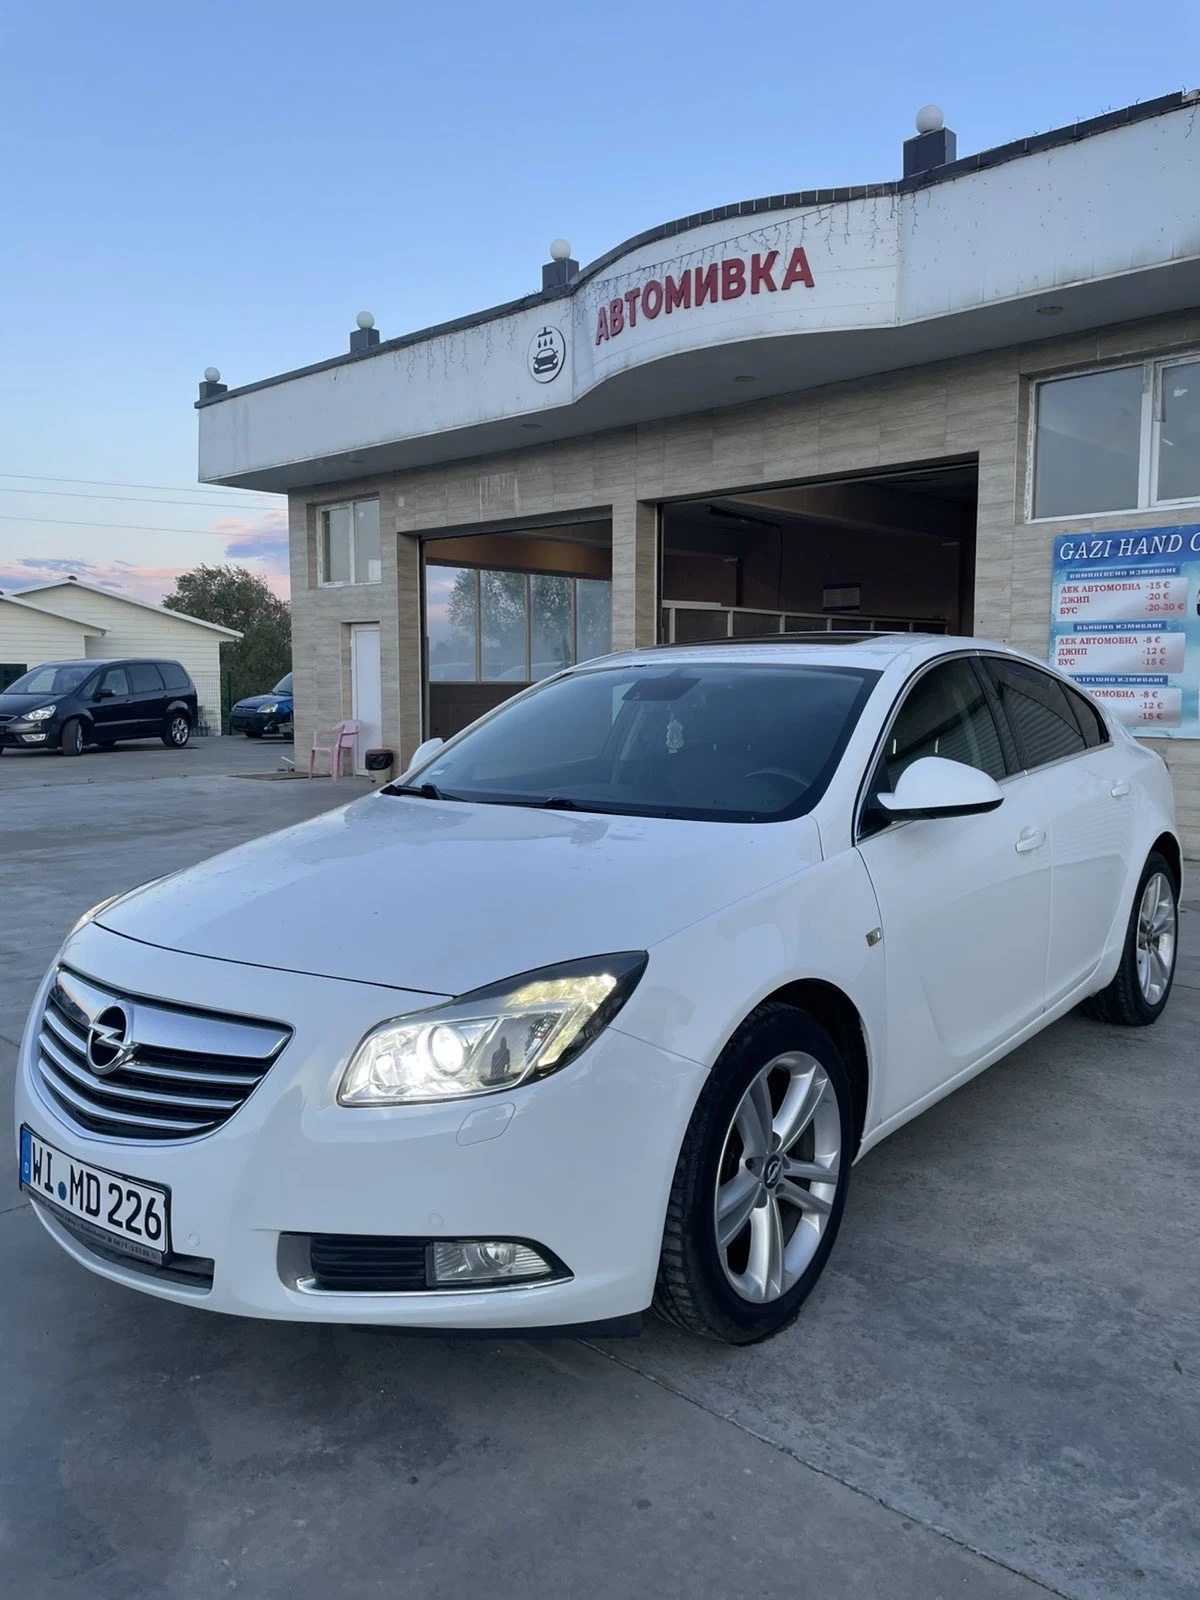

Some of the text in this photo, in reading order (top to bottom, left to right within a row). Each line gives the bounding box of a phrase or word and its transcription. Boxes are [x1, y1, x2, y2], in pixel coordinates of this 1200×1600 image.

[595, 246, 816, 346] АВТОМИВКА
[1060, 539, 1113, 561] GAZI
[1117, 533, 1183, 557] HAND
[1060, 581, 1170, 594] ЛЕК АВТОМОБИЛ -15 €
[1060, 592, 1170, 605] ДЖИП -20 €
[1060, 606, 1078, 615] БУС
[1058, 637, 1077, 645] ЛЕК
[1079, 636, 1138, 645] АВТОМОБИЛ
[1154, 636, 1161, 644] €
[1057, 647, 1167, 656] ДЖИП -12 €
[1057, 658, 1167, 666] БУС -15 €
[1089, 689, 1136, 699] ТОМОБИЛ
[1152, 690, 1159, 699] €
[1139, 701, 1164, 710] -12 €
[1138, 712, 1164, 720] -15 €
[32, 1141, 54, 1195] WI
[69, 1164, 102, 1218] MD
[106, 1182, 163, 1241] 226
